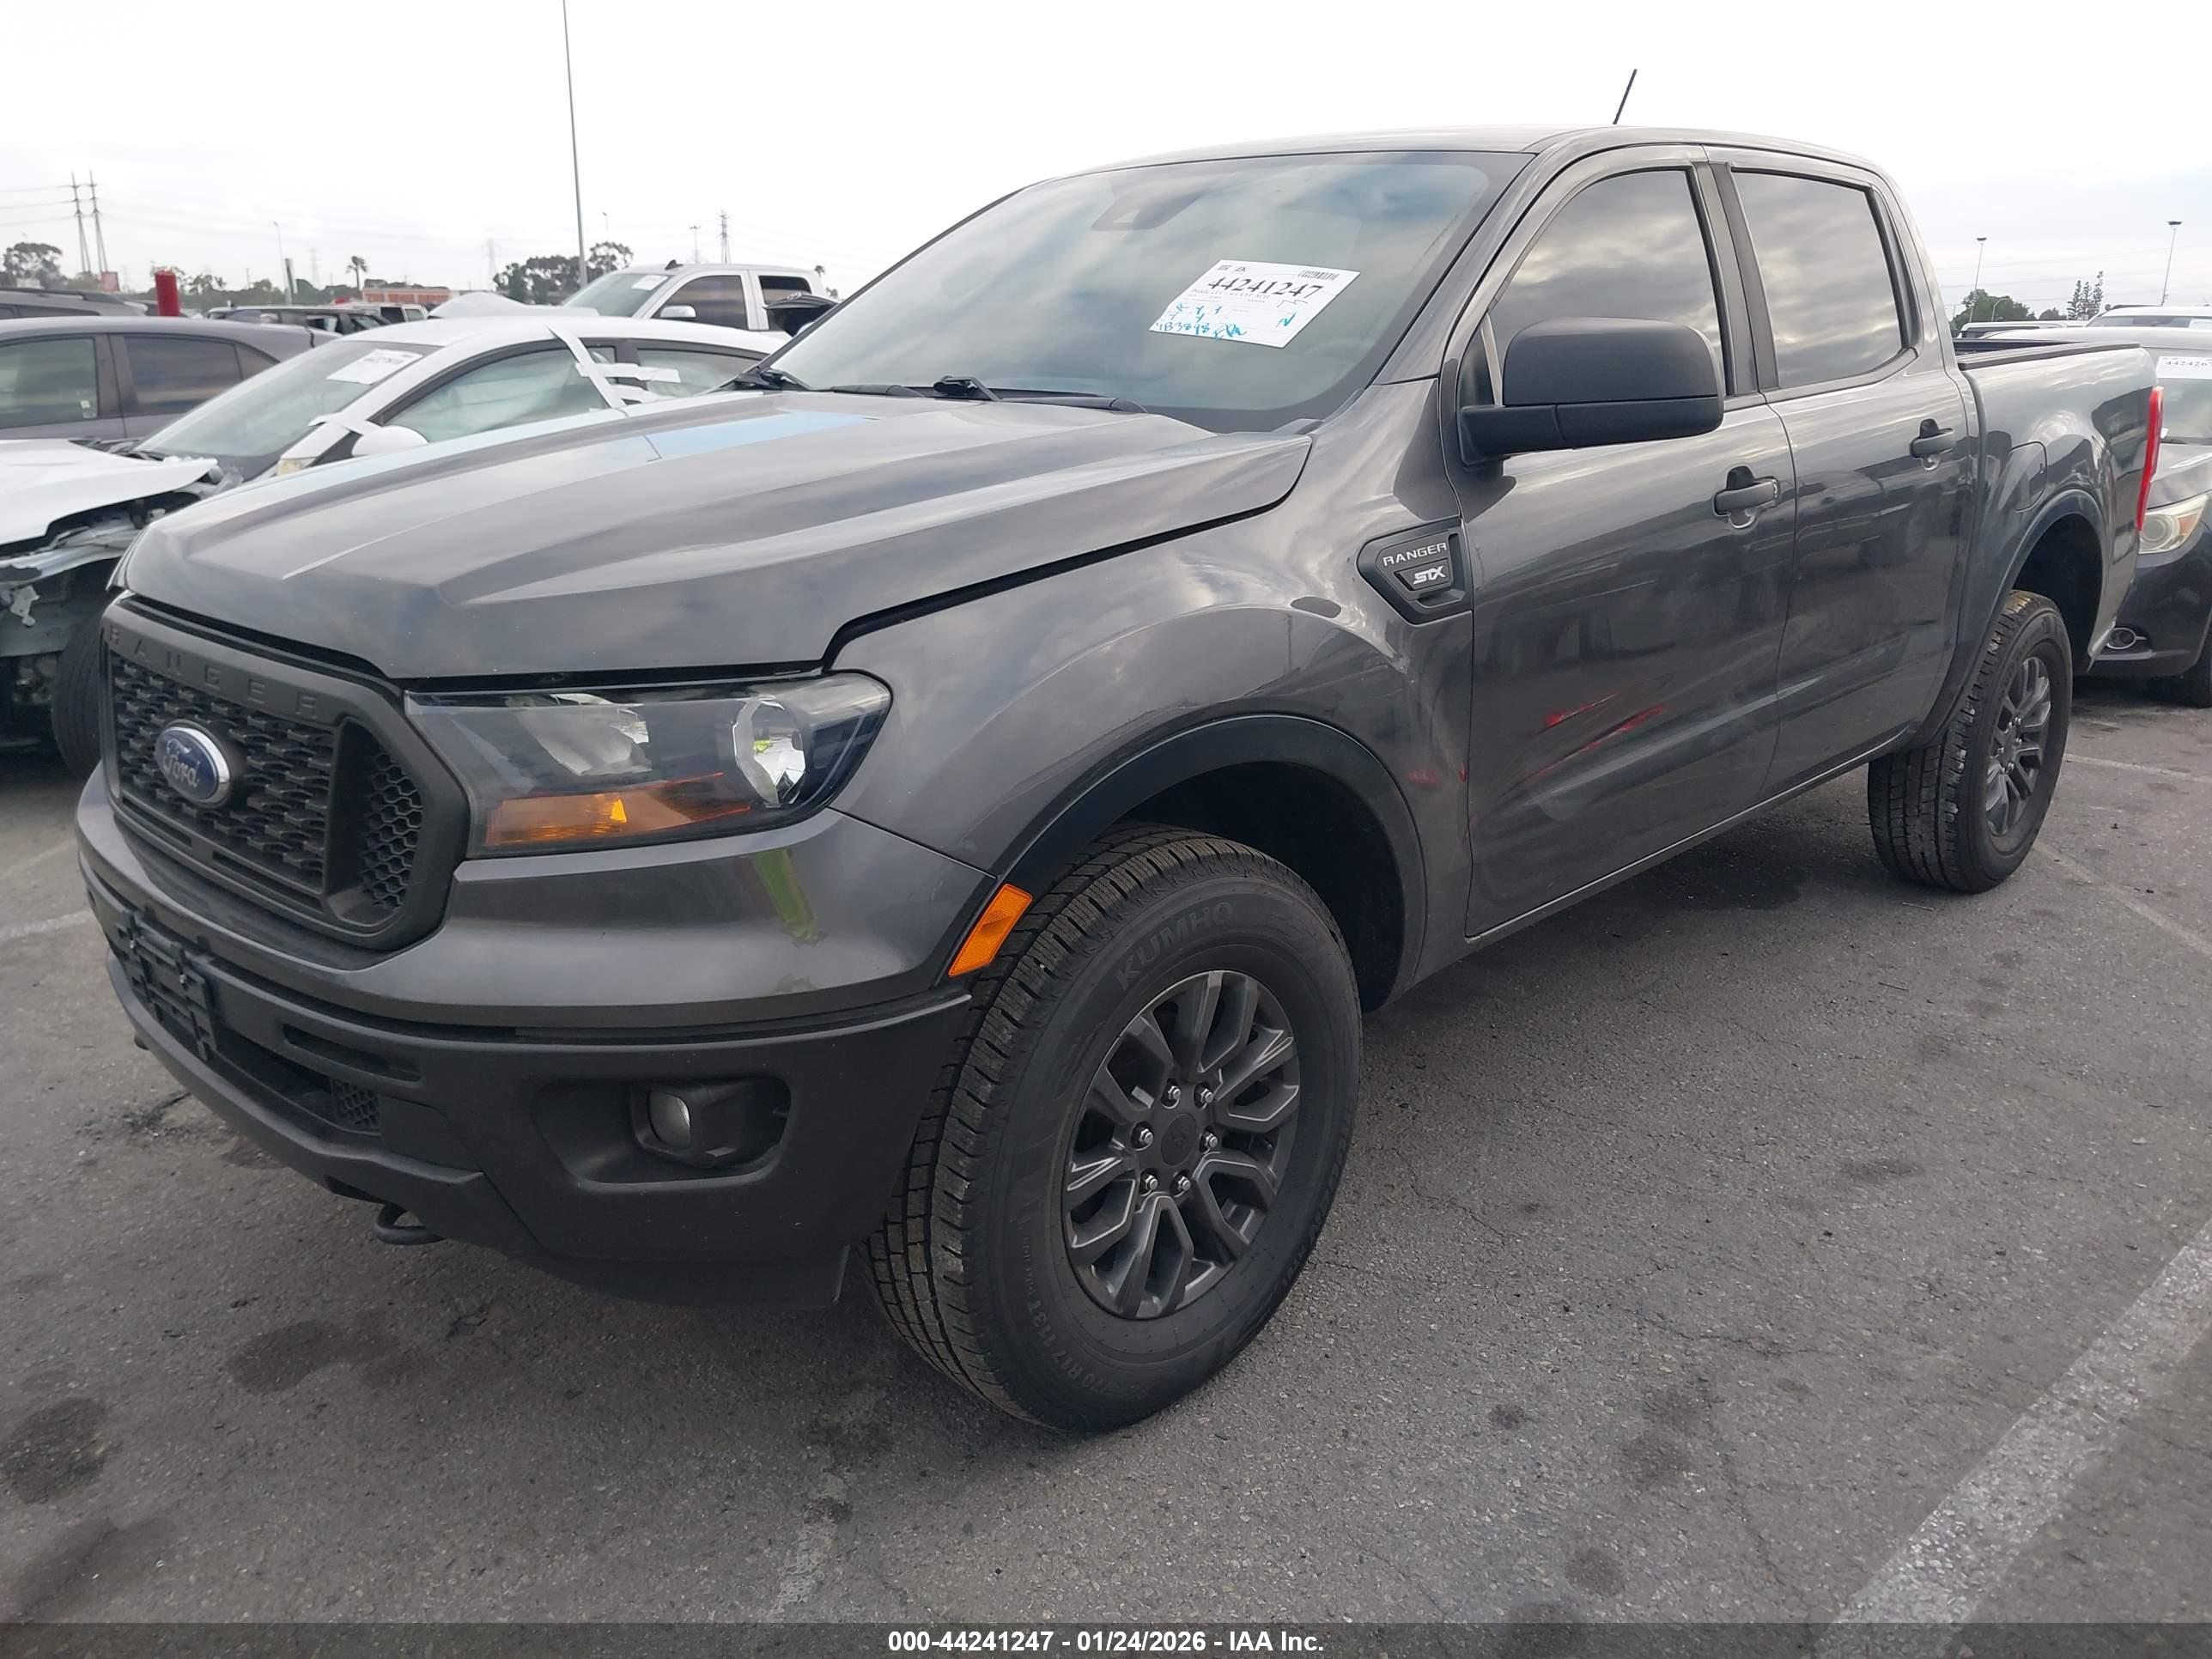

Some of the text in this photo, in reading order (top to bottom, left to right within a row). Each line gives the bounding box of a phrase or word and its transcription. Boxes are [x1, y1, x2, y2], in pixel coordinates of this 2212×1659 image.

[1207, 276, 1324, 299] 44241247
[1382, 542, 1448, 567] RANGER
[1413, 565, 1447, 585] STX
[163, 738, 201, 788] Ford
[1117, 902, 1233, 991] KUMHO
